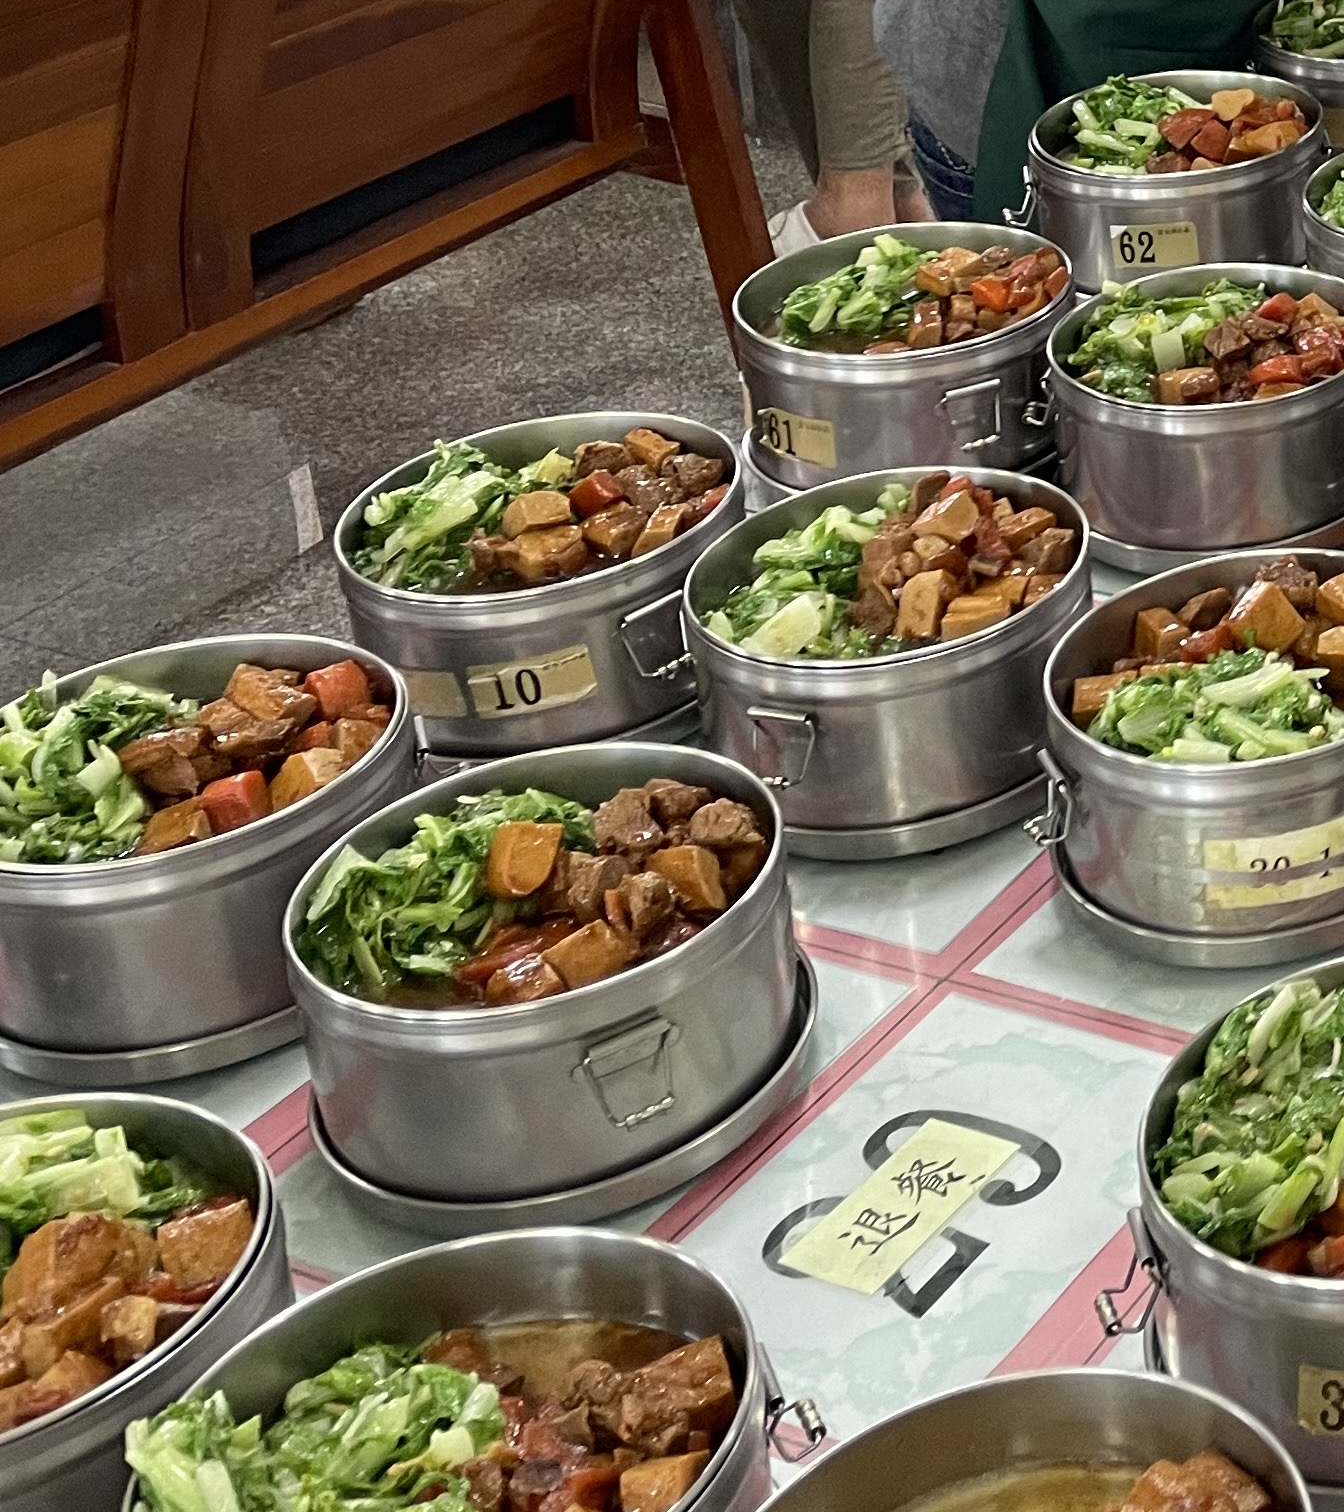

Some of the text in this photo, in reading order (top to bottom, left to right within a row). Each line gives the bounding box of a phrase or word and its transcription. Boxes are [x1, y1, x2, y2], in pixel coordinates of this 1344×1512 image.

[1119, 230, 1156, 264] 62
[768, 412, 797, 457] 61
[495, 668, 542, 710] 10
